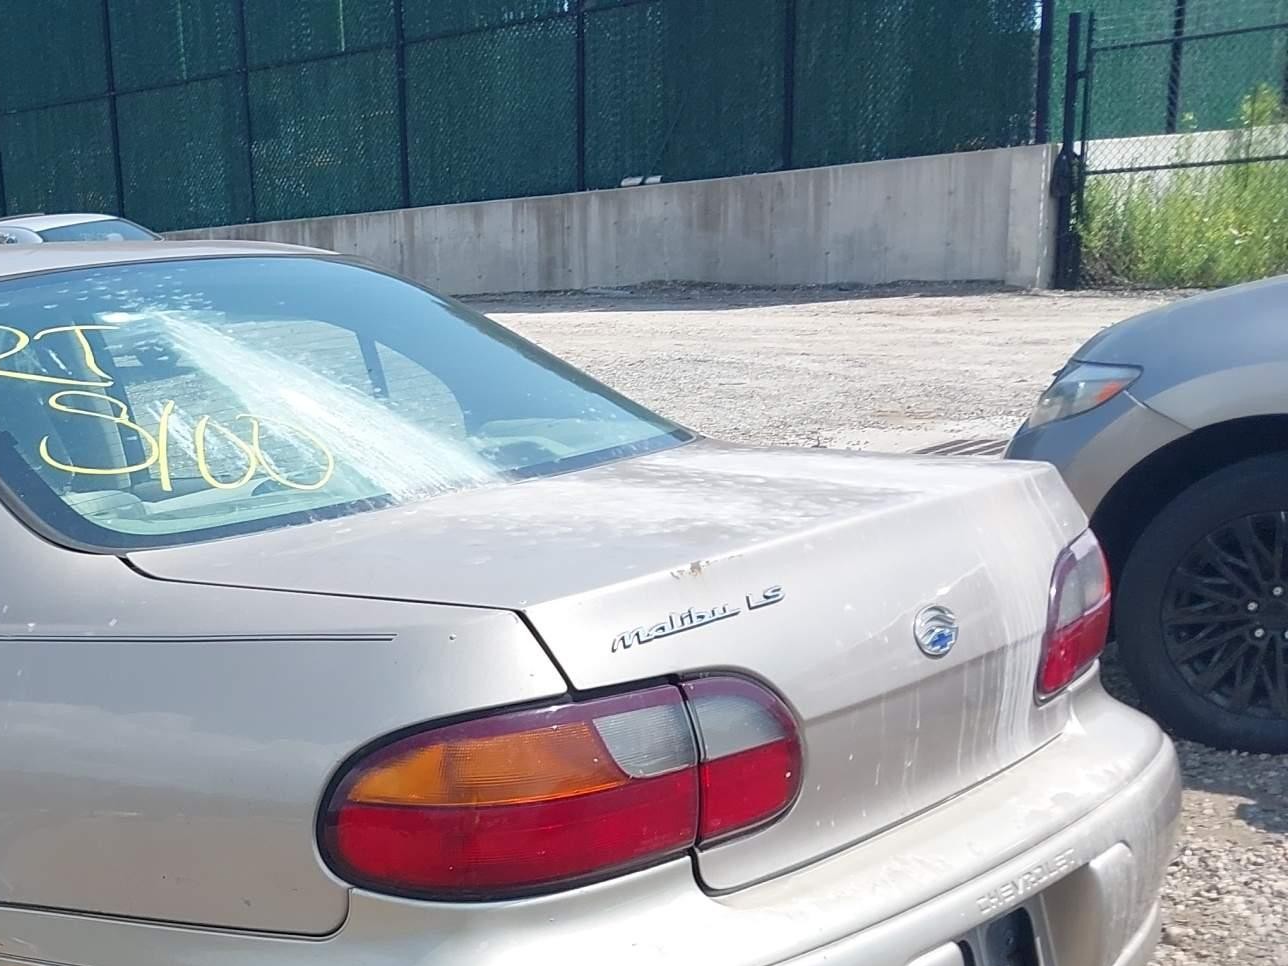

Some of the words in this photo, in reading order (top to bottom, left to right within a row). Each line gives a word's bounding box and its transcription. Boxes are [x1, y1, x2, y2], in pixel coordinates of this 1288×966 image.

[611, 603, 742, 654] Malibu
[745, 584, 787, 611] LS
[975, 848, 1078, 915] CHEVROLET
